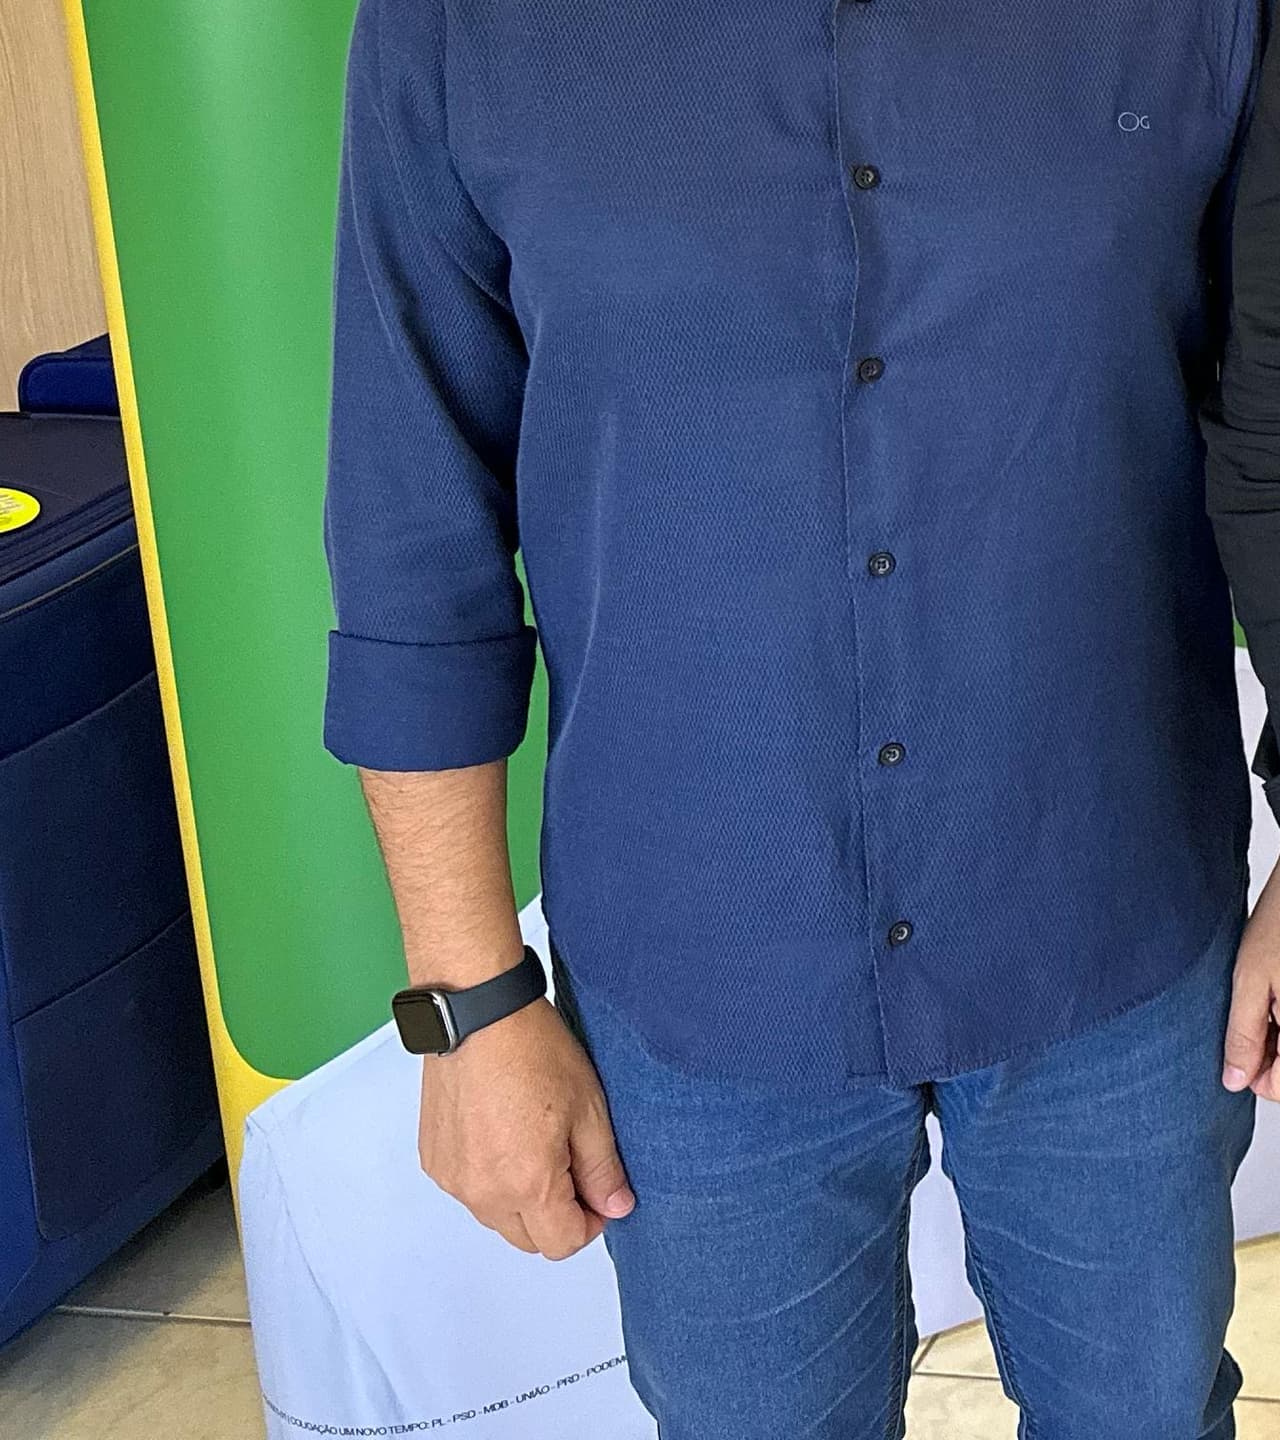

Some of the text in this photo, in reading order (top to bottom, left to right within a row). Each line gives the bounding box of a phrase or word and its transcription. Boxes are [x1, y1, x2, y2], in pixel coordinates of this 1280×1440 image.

[356, 1426, 387, 1436] NOVO
[431, 1418, 444, 1428] PL
[452, 1409, 476, 1423] PSD
[515, 1384, 550, 1404] UNIÃO
